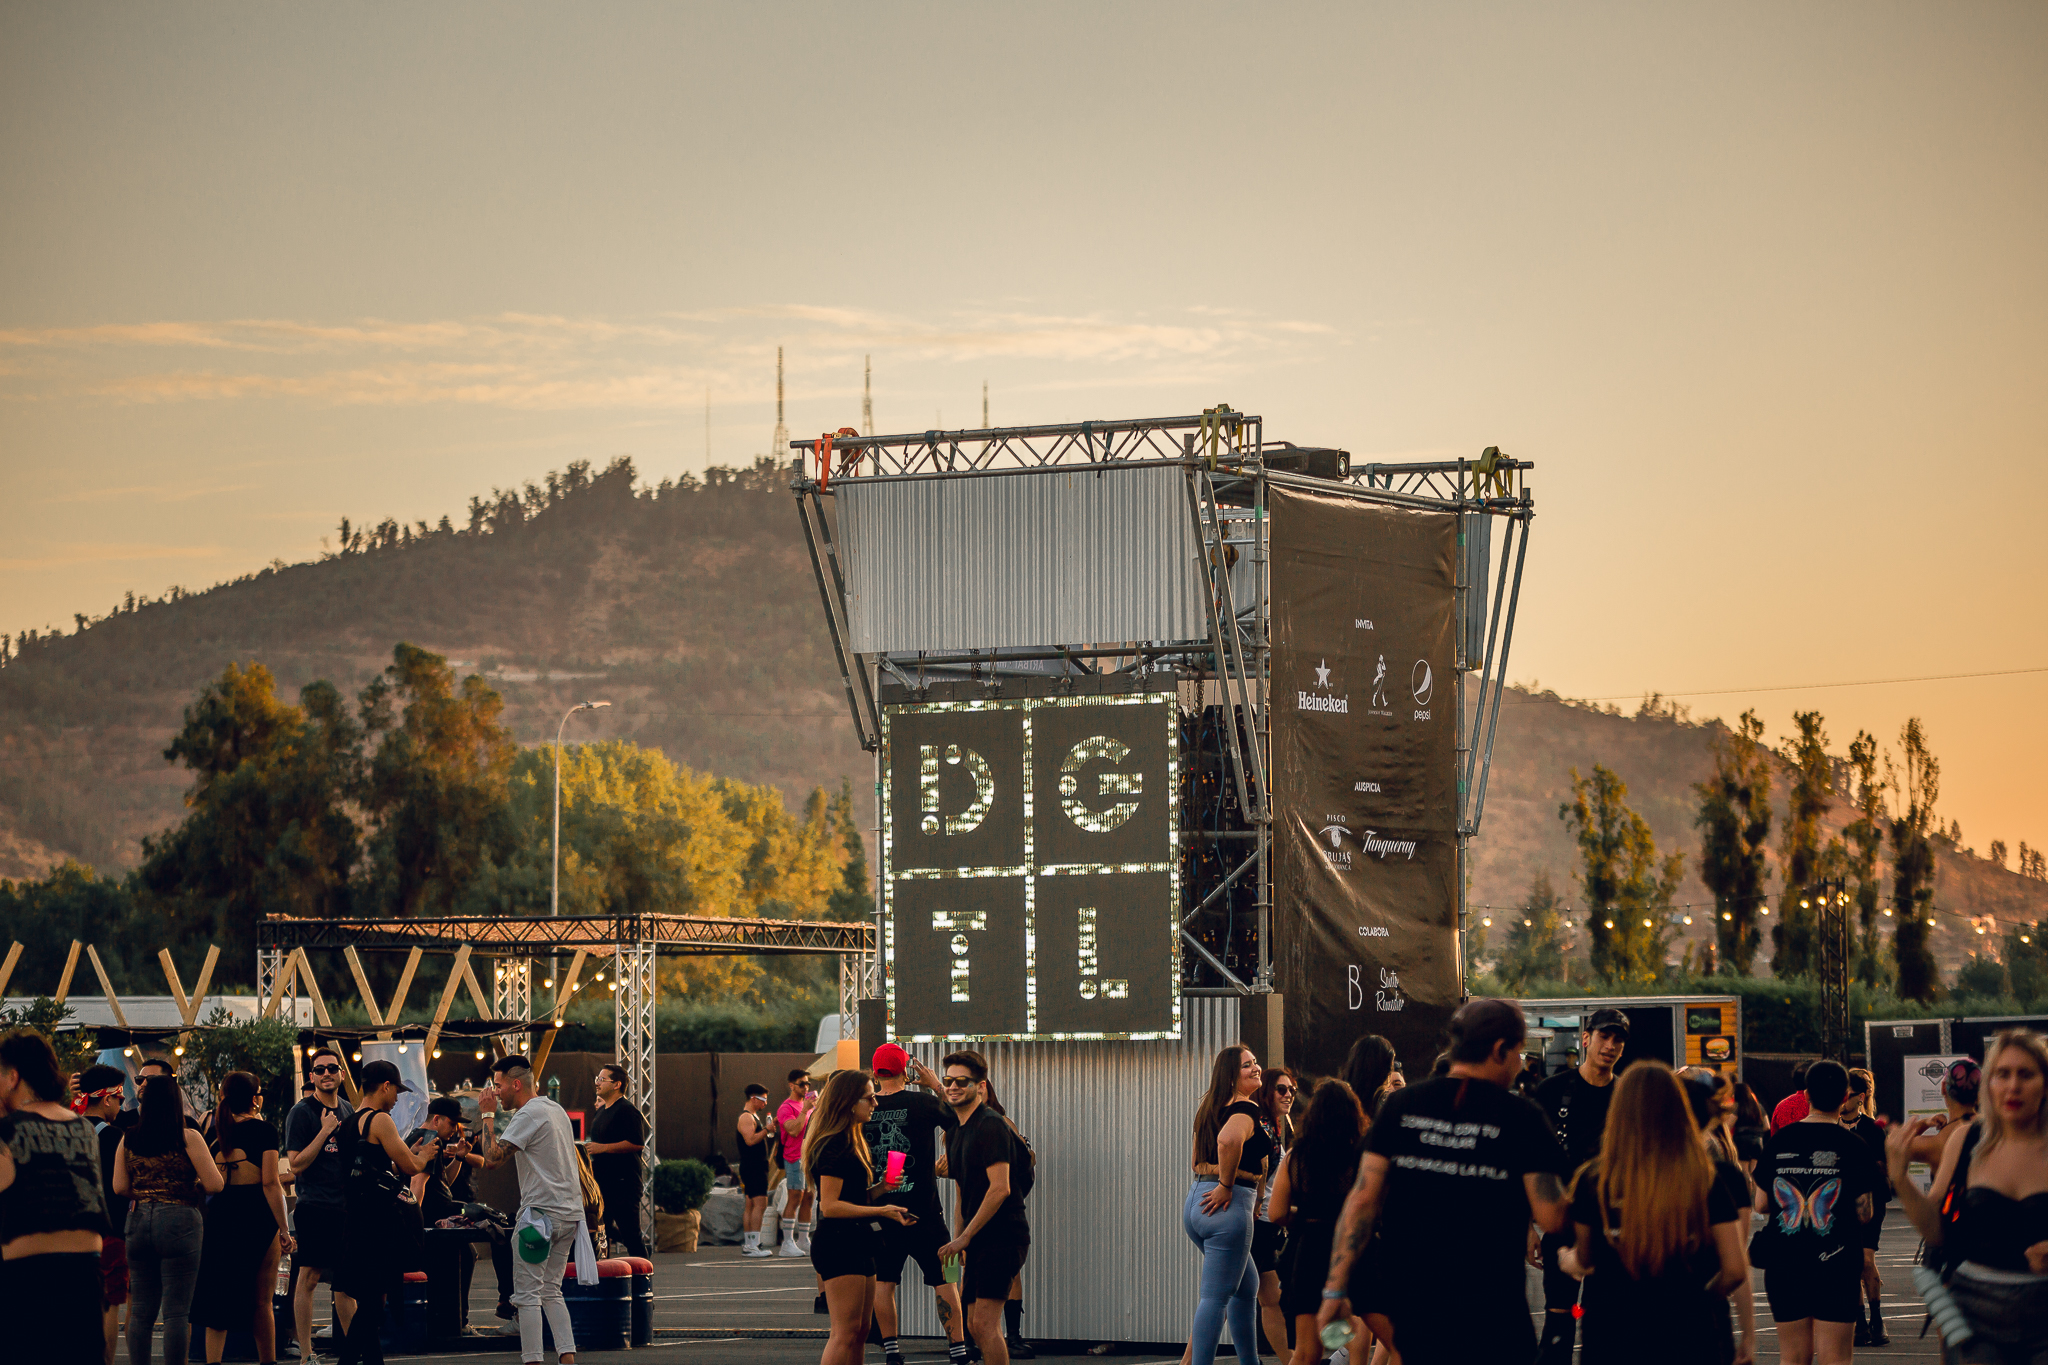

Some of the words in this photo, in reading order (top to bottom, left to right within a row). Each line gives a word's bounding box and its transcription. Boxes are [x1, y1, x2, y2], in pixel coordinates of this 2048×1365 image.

[1298, 691, 1348, 713] Heineken
[1414, 709, 1431, 721] pepsi
[1354, 781, 1381, 793] AUSPICIA
[1326, 814, 1346, 823] PISCO
[1363, 829, 1416, 860] Tanqueray
[1358, 926, 1389, 937] COLABORA
[1348, 965, 1362, 1010] B
